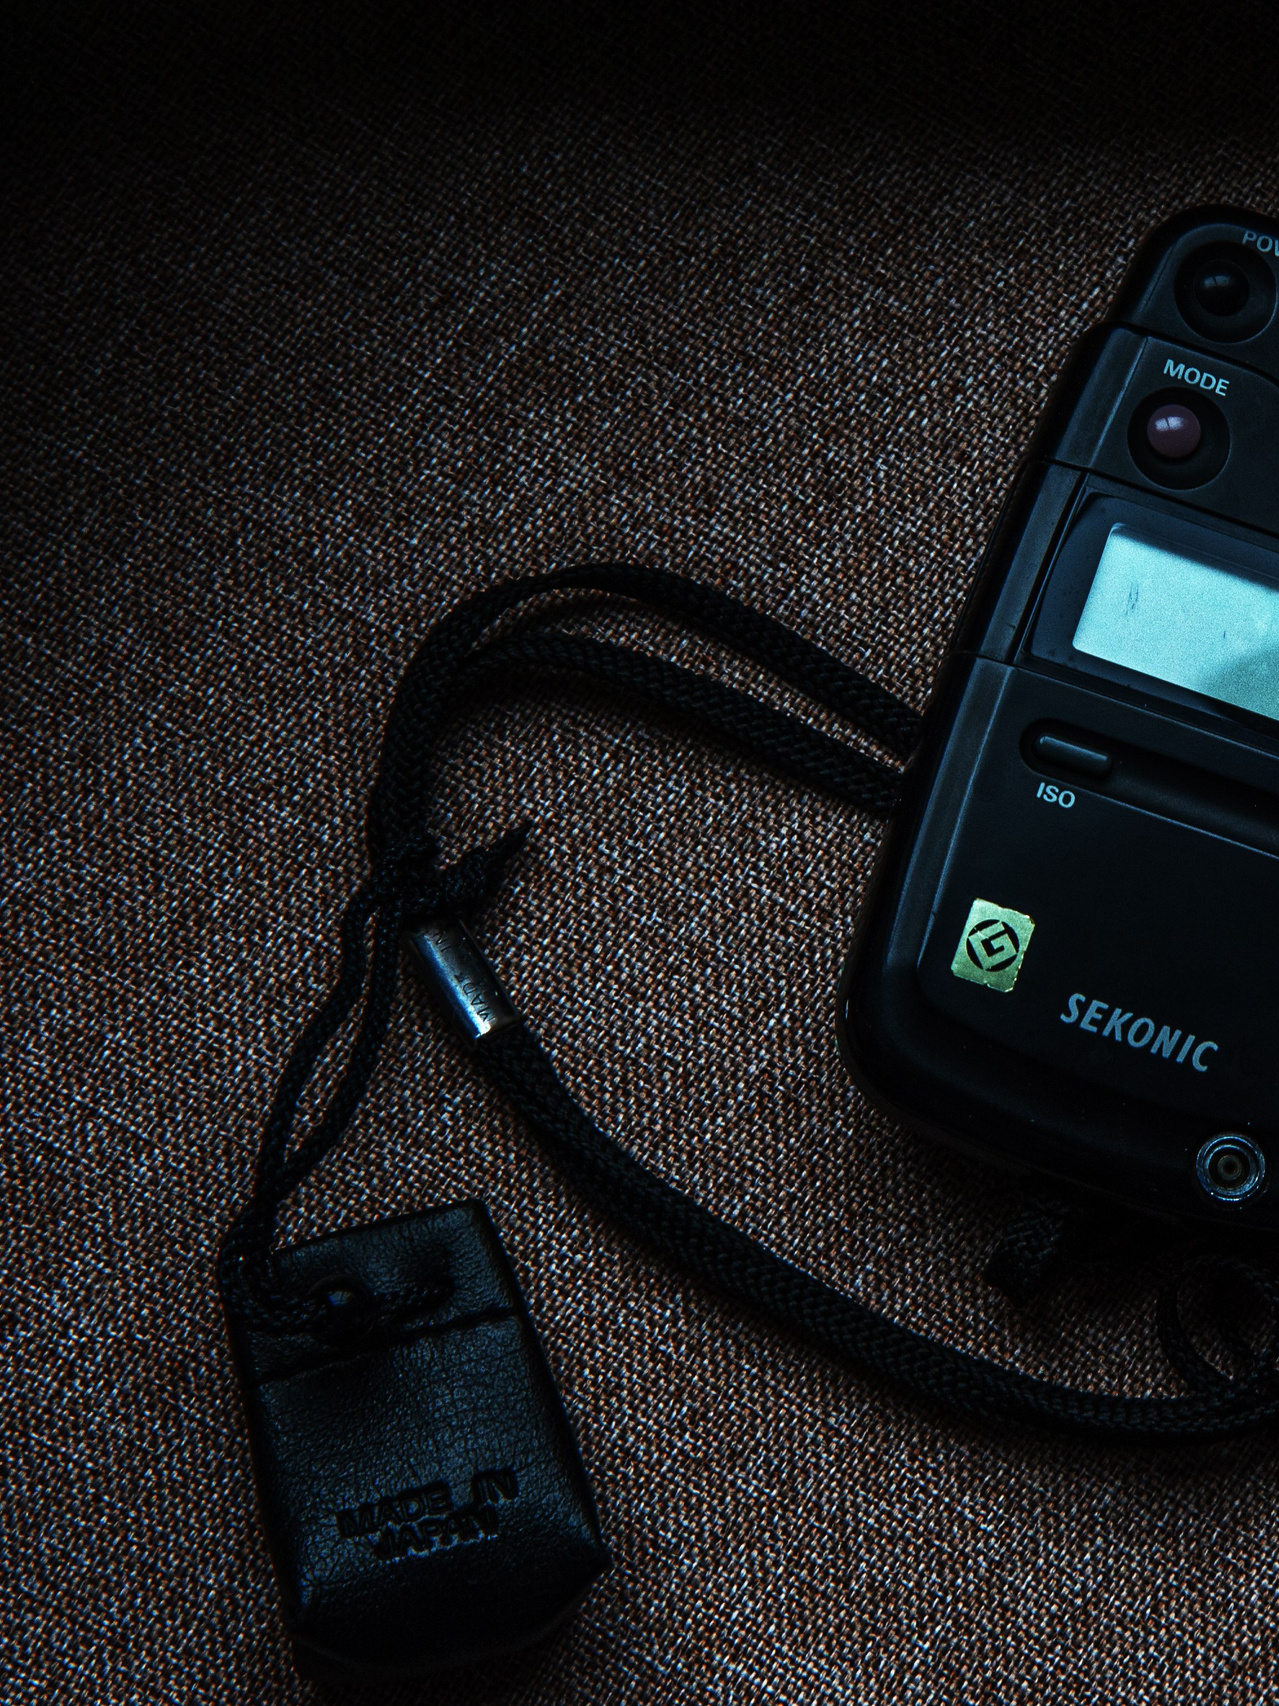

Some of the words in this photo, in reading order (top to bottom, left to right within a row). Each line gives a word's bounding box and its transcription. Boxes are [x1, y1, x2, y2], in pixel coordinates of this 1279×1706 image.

[1163, 359, 1230, 396] MODE
[1036, 782, 1076, 808] ISO
[1060, 993, 1219, 1072] SEKONIC
[337, 1485, 450, 1537] MADE
[473, 1473, 518, 1503] IN
[376, 1509, 499, 1559] JAPAN
